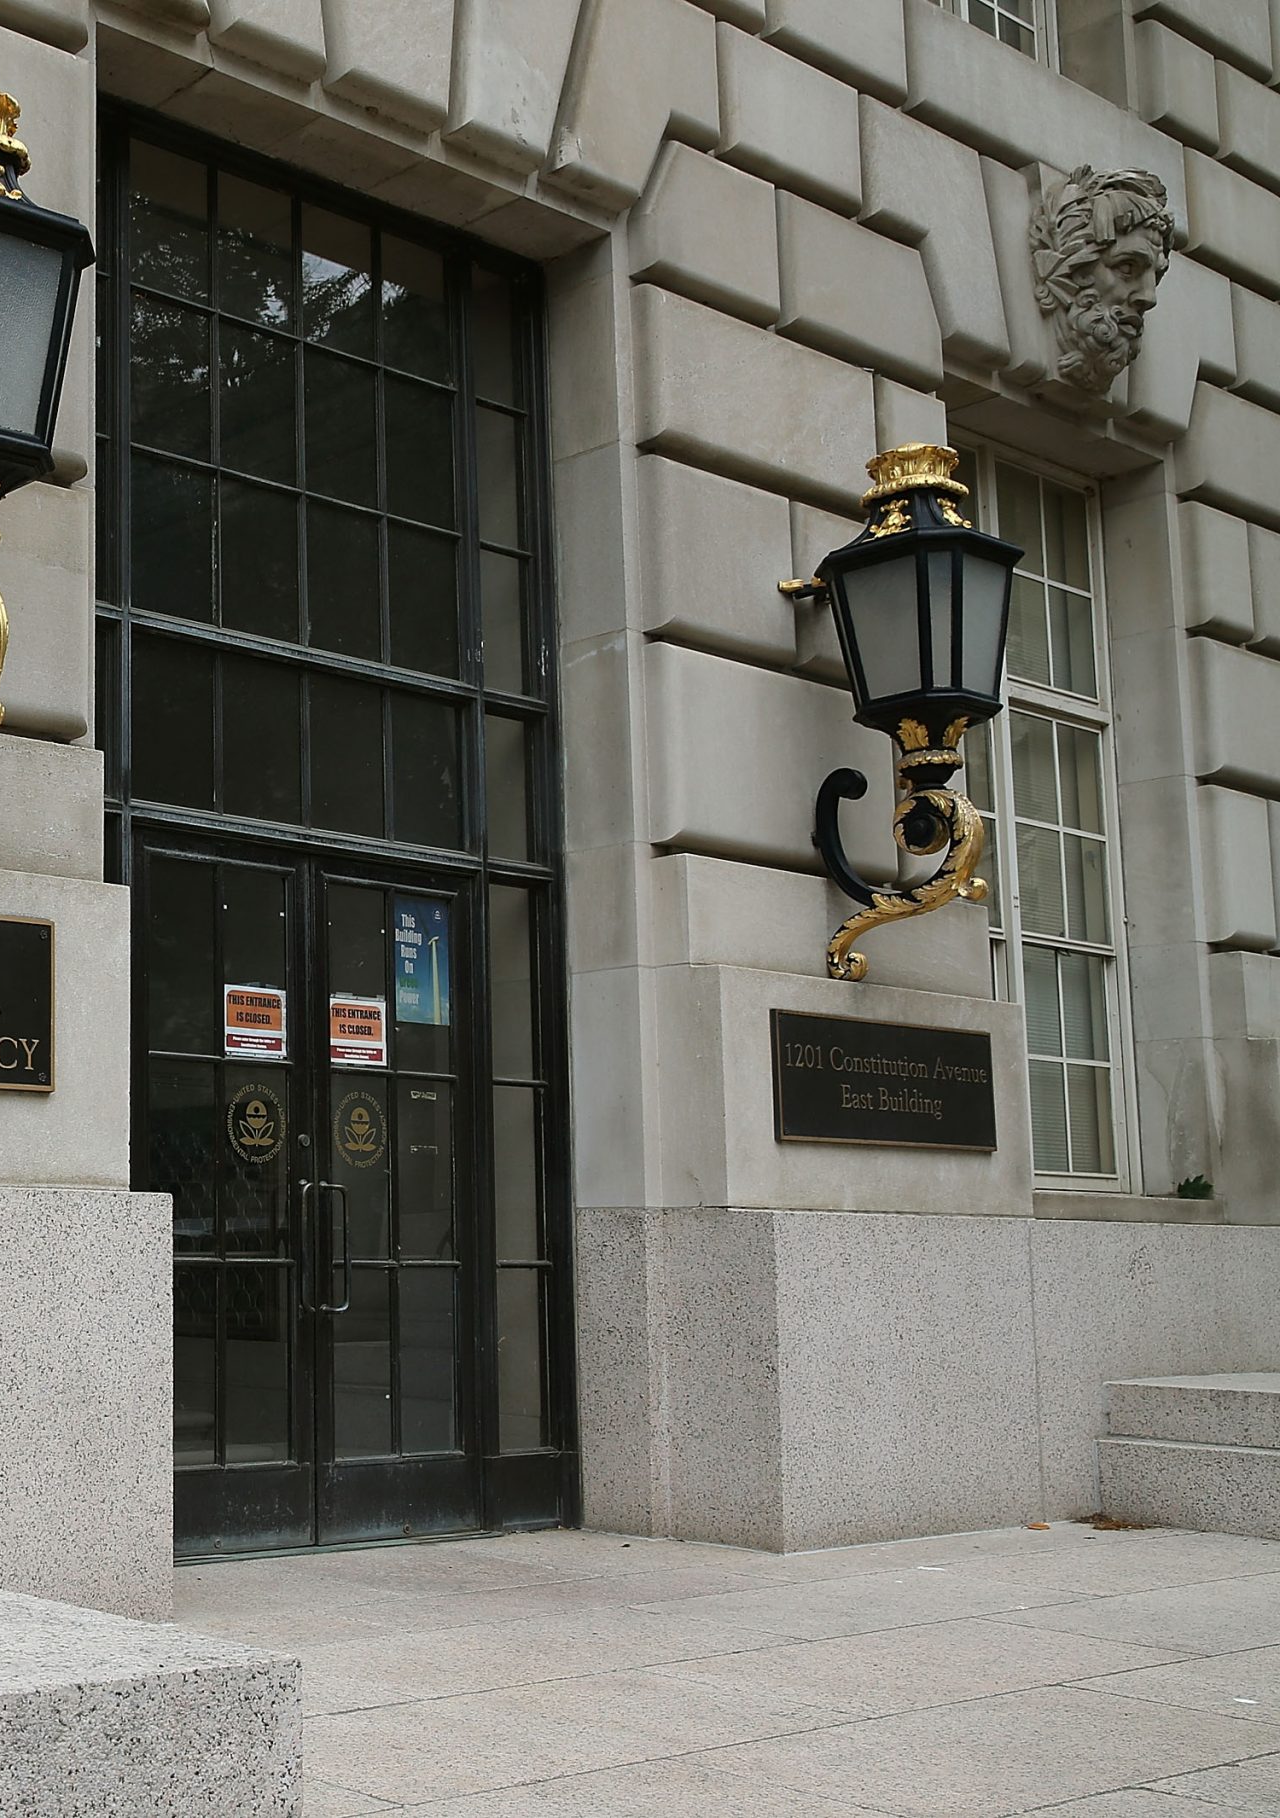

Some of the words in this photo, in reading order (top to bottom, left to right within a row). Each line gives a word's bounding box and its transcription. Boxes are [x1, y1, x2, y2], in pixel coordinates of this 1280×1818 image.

[401, 913, 416, 928] This
[395, 928, 422, 946] Building
[400, 944, 417, 959] Runs
[404, 960, 414, 974] On
[228, 994, 245, 1005] THIS
[246, 996, 281, 1009] ENTRANCE
[236, 1011, 244, 1022] IS
[245, 1012, 272, 1025] CLOSED.
[331, 1007, 347, 1018] THIS
[348, 1009, 382, 1021] ENTRANCE
[339, 1024, 347, 1034] IS
[348, 1024, 374, 1036] CLOSED.
[784, 1043, 824, 1069] 1201
[830, 1046, 928, 1079] Constitution
[933, 1057, 988, 1083] Avenue
[233, 1084, 255, 1102] UNITED
[257, 1084, 278, 1104] STATES
[840, 1084, 873, 1110] East
[878, 1087, 944, 1120] Building
[227, 1103, 249, 1161] ENVIRONMENTAL
[250, 1139, 283, 1164] PROTECTION
